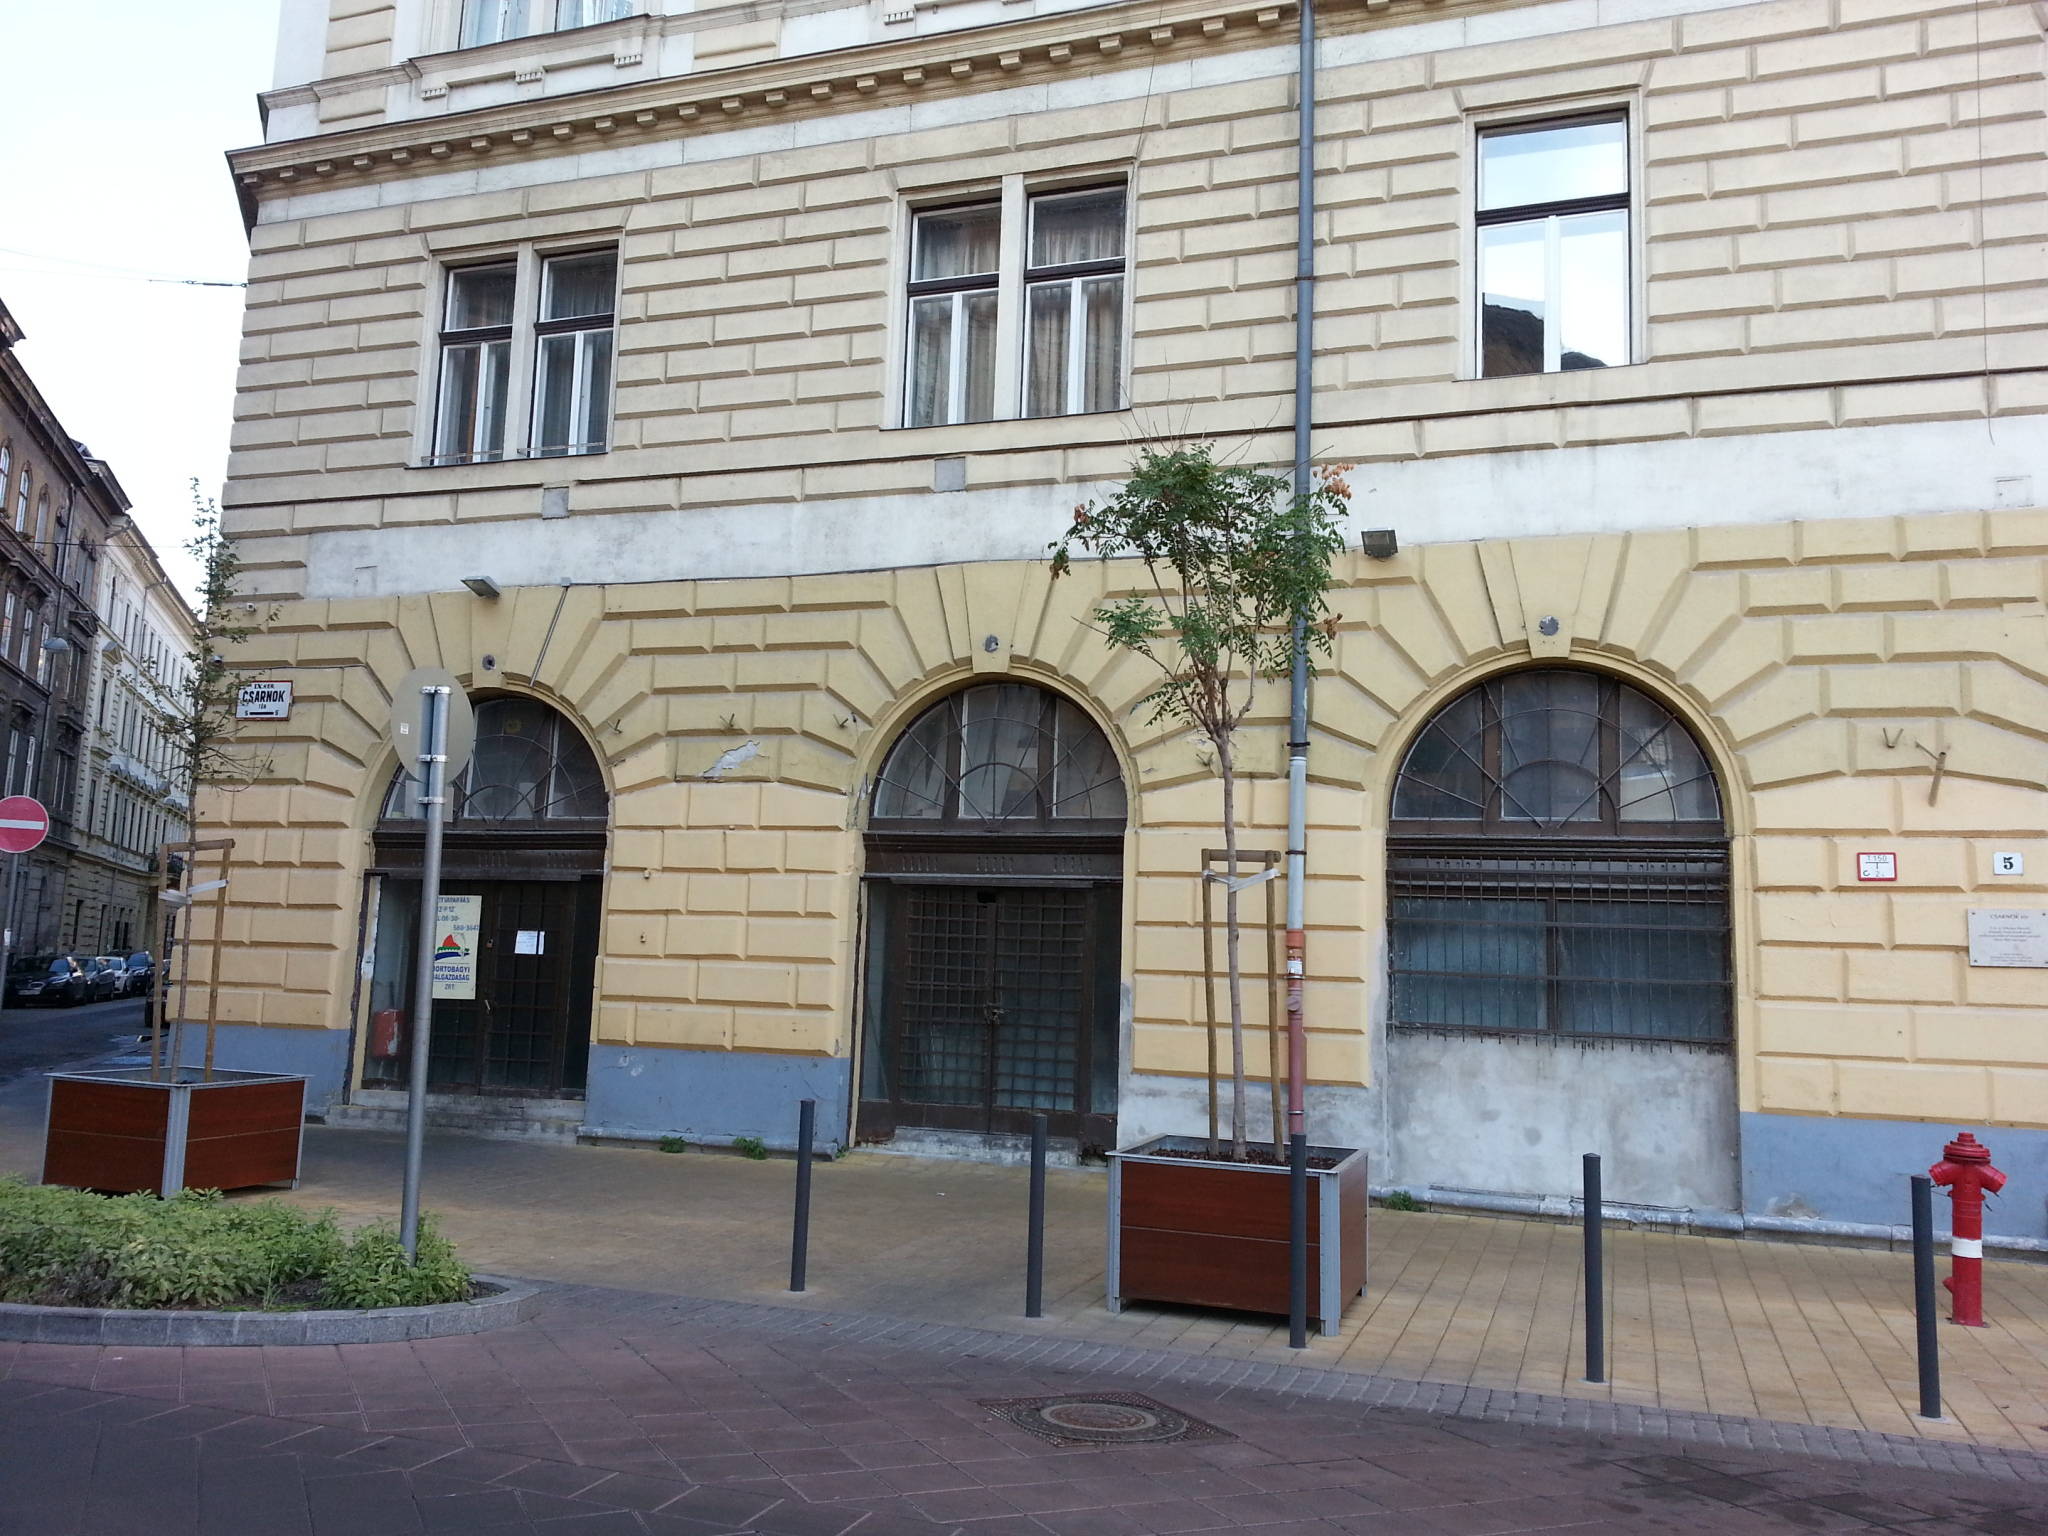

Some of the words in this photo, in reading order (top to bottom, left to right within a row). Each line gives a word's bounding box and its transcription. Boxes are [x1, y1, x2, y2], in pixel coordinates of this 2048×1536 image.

[242, 690, 286, 703] CSARNOK
[2002, 856, 2014, 870] 5
[432, 973, 470, 981] ALGAZDASÁG
